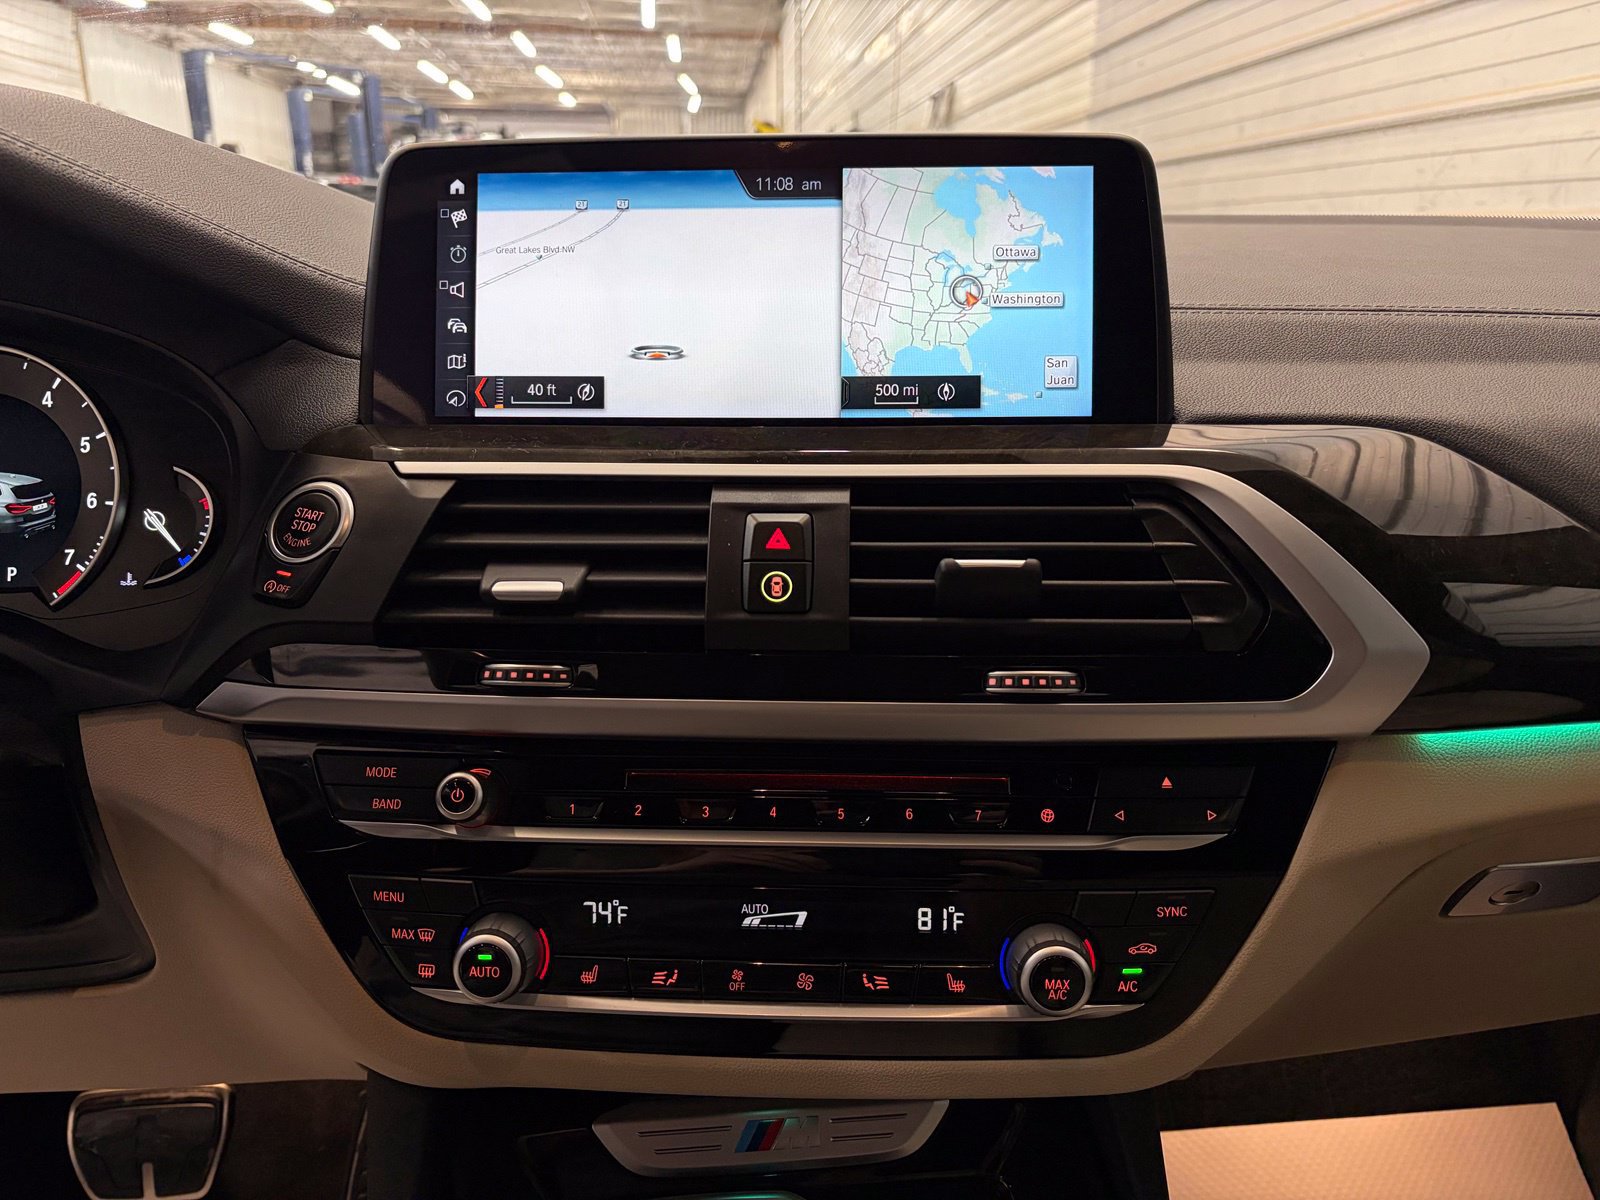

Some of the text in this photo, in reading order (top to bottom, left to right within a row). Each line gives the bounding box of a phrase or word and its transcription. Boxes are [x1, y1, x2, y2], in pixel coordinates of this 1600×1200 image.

[757, 177, 821, 190] 11:08 am
[495, 246, 517, 254] Great
[518, 245, 541, 254] Lakes
[562, 245, 576, 253] NW
[995, 247, 1036, 258] Ottawa
[991, 293, 1060, 306] Washington
[1046, 358, 1069, 369] San
[1046, 374, 1075, 386] Juan
[528, 384, 556, 395] 40 ft
[875, 384, 918, 396] 500 mi
[42, 391, 53, 407] 4
[80, 437, 90, 453] 5
[87, 493, 97, 508] 6
[294, 507, 325, 522] START
[291, 520, 317, 532] STOP
[283, 532, 312, 547] ENGINE
[65, 549, 75, 566] 7
[7, 567, 17, 581] P
[276, 584, 291, 593] OFF
[366, 767, 397, 777] MODE
[373, 799, 401, 809] BAND
[570, 804, 574, 814] 1
[635, 805, 641, 816] 2
[703, 806, 709, 817] 3
[770, 807, 776, 817] 4
[838, 808, 844, 819] 5
[906, 808, 913, 819] 6
[976, 810, 981, 821] 7
[374, 891, 404, 902] MENU
[583, 900, 628, 924] 74°F
[741, 904, 768, 914] AUTO
[1157, 907, 1187, 917] SYNC
[918, 906, 964, 931] 81°F
[392, 928, 414, 939] MAX
[469, 966, 499, 977] AUTO
[729, 982, 746, 991] OFF
[1045, 979, 1070, 990] MAX
[1118, 981, 1137, 992] A/C
[1048, 990, 1067, 1000] A/C
